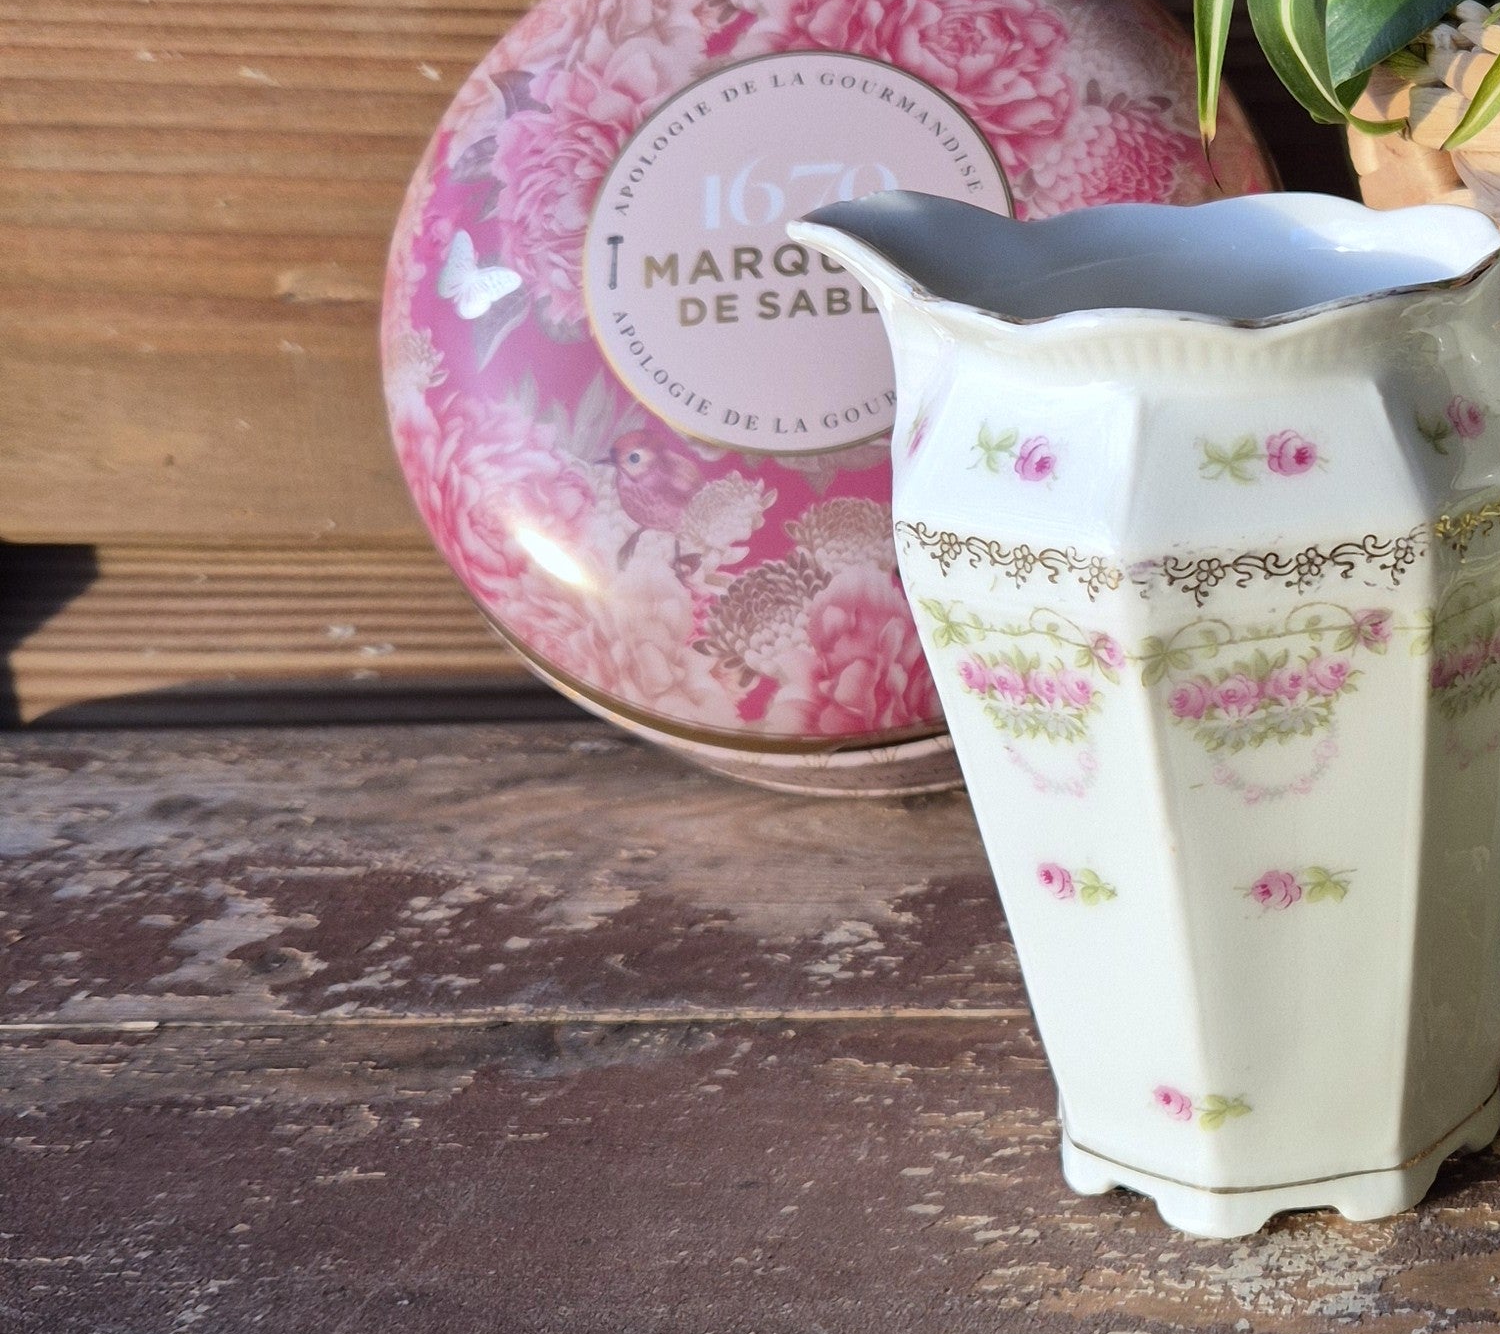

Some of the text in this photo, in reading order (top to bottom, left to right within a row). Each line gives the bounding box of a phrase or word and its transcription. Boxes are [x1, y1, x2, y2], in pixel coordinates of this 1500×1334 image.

[613, 71, 984, 216] APOLOGIE DE LA GOURMANDISE
[679, 285, 880, 327] DE SABL
[612, 310, 809, 434] APOLOGIE DE LA
